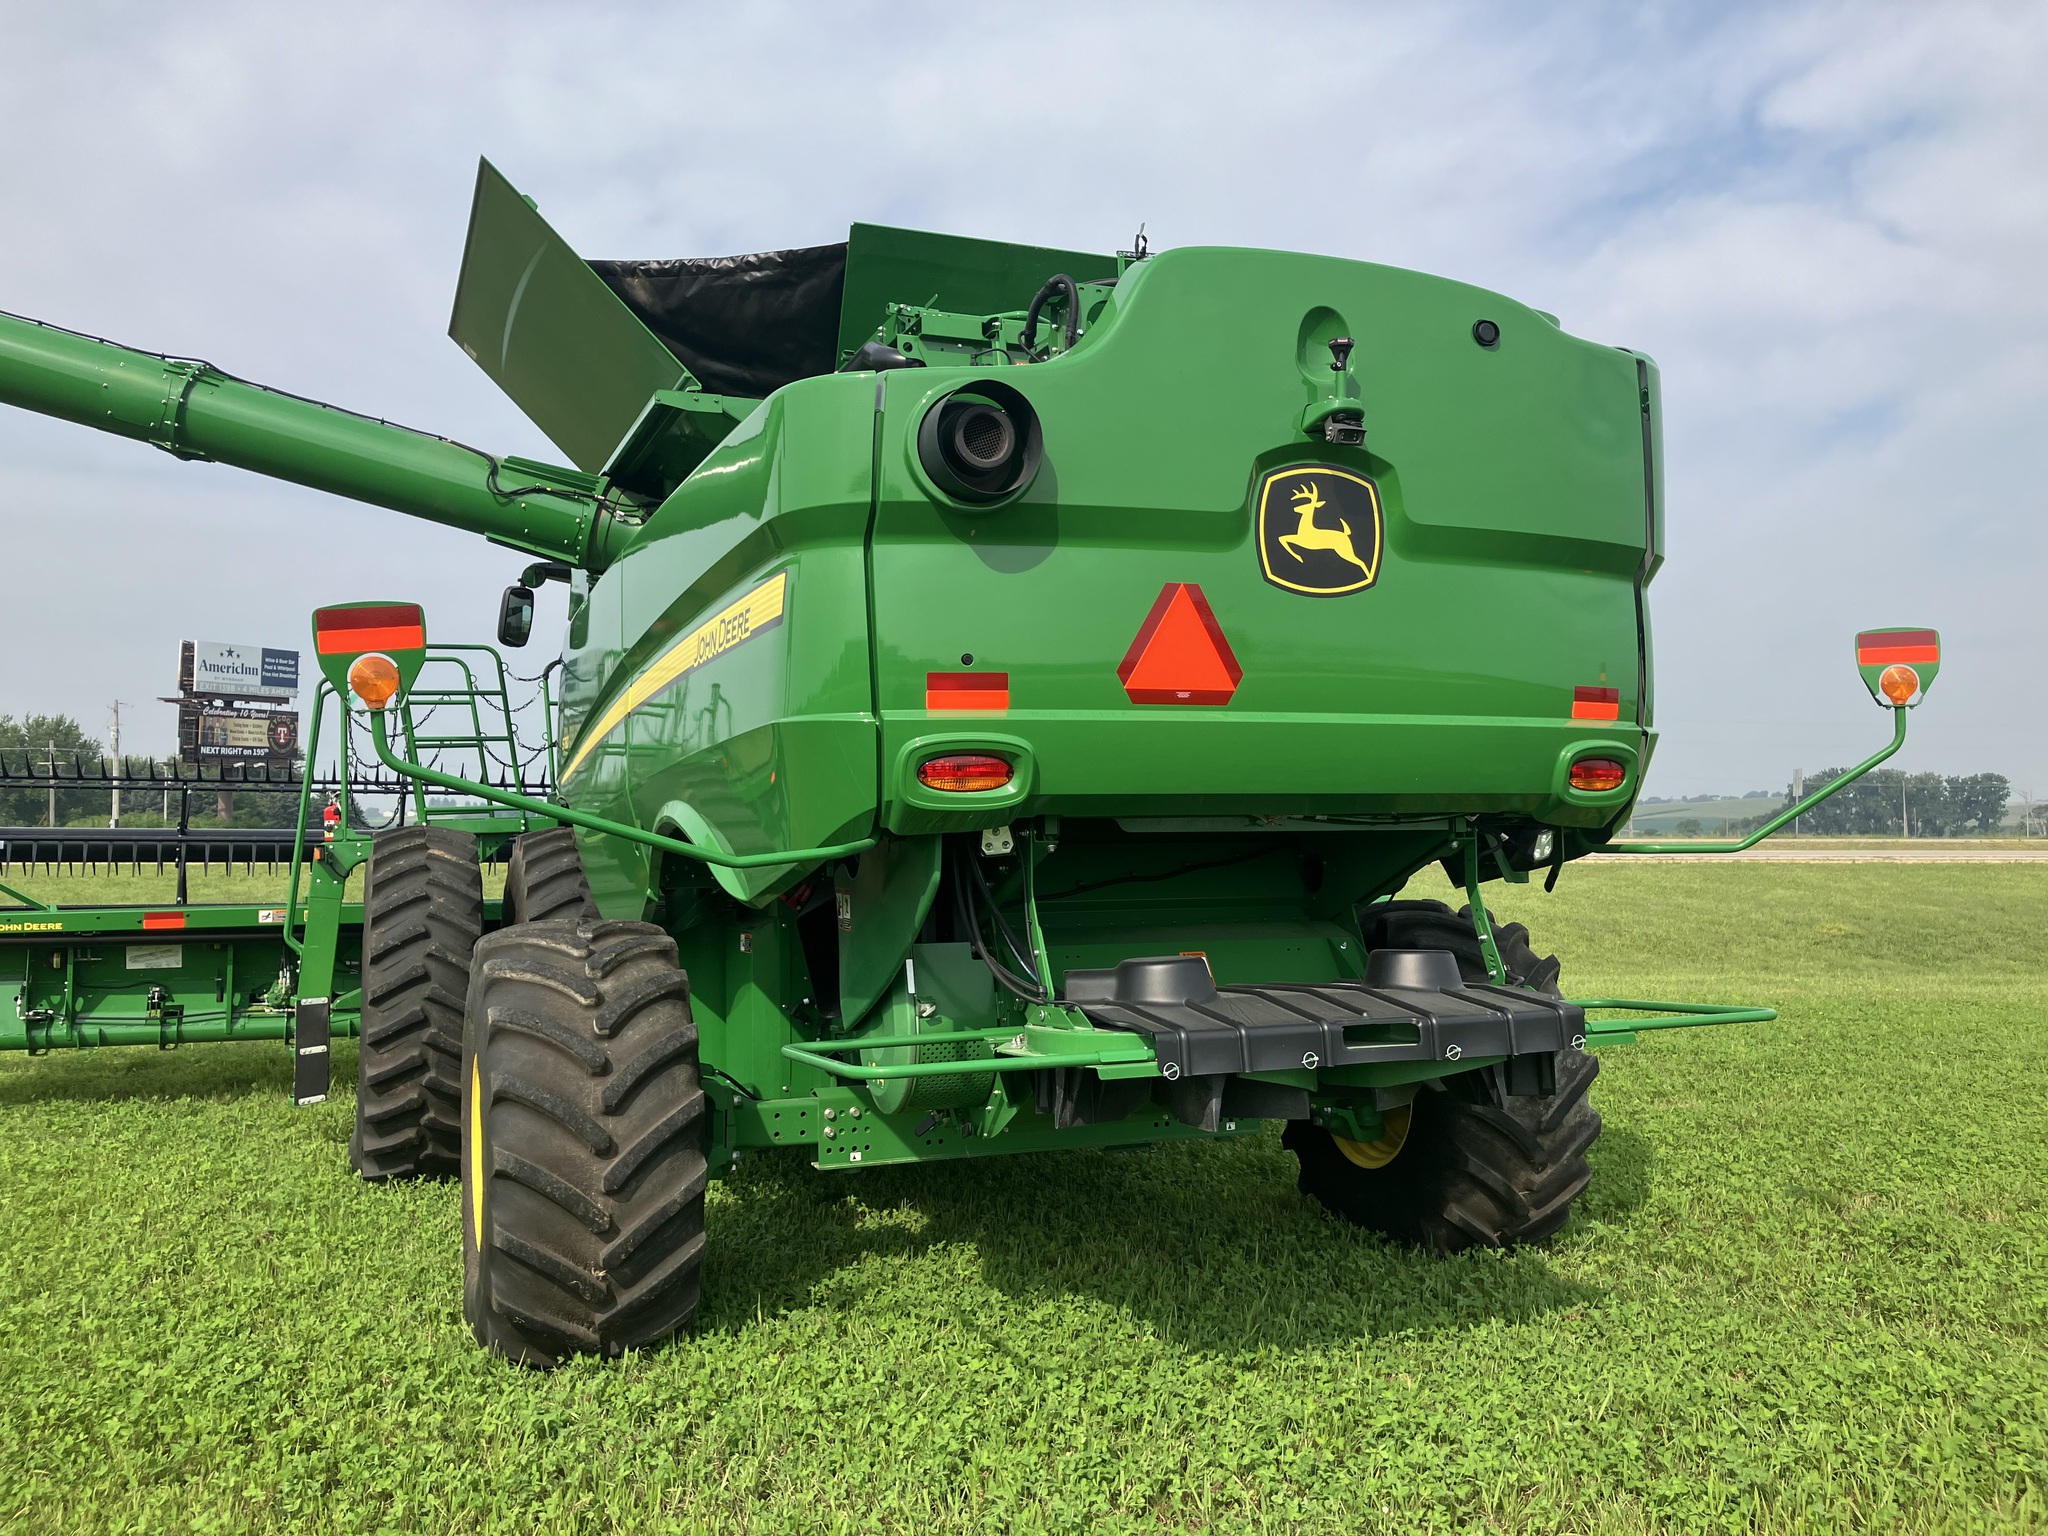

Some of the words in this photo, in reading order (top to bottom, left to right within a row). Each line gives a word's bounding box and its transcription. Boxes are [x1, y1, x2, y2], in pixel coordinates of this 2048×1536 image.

[694, 628, 718, 664] JOHN
[718, 607, 751, 649] DEERE
[199, 659, 258, 676] AmericInn
[200, 682, 217, 691] EXIT
[219, 684, 235, 692] 139B
[242, 685, 247, 693] 4
[249, 686, 269, 695] MILES
[270, 688, 295, 696] AHEAD
[203, 706, 237, 718] Celebrating
[240, 709, 249, 717] 10
[250, 710, 269, 719] Years!
[278, 727, 287, 742] T
[201, 746, 220, 754] NEXT
[220, 747, 242, 755] RIGHT
[24, 922, 63, 931] DEERE
